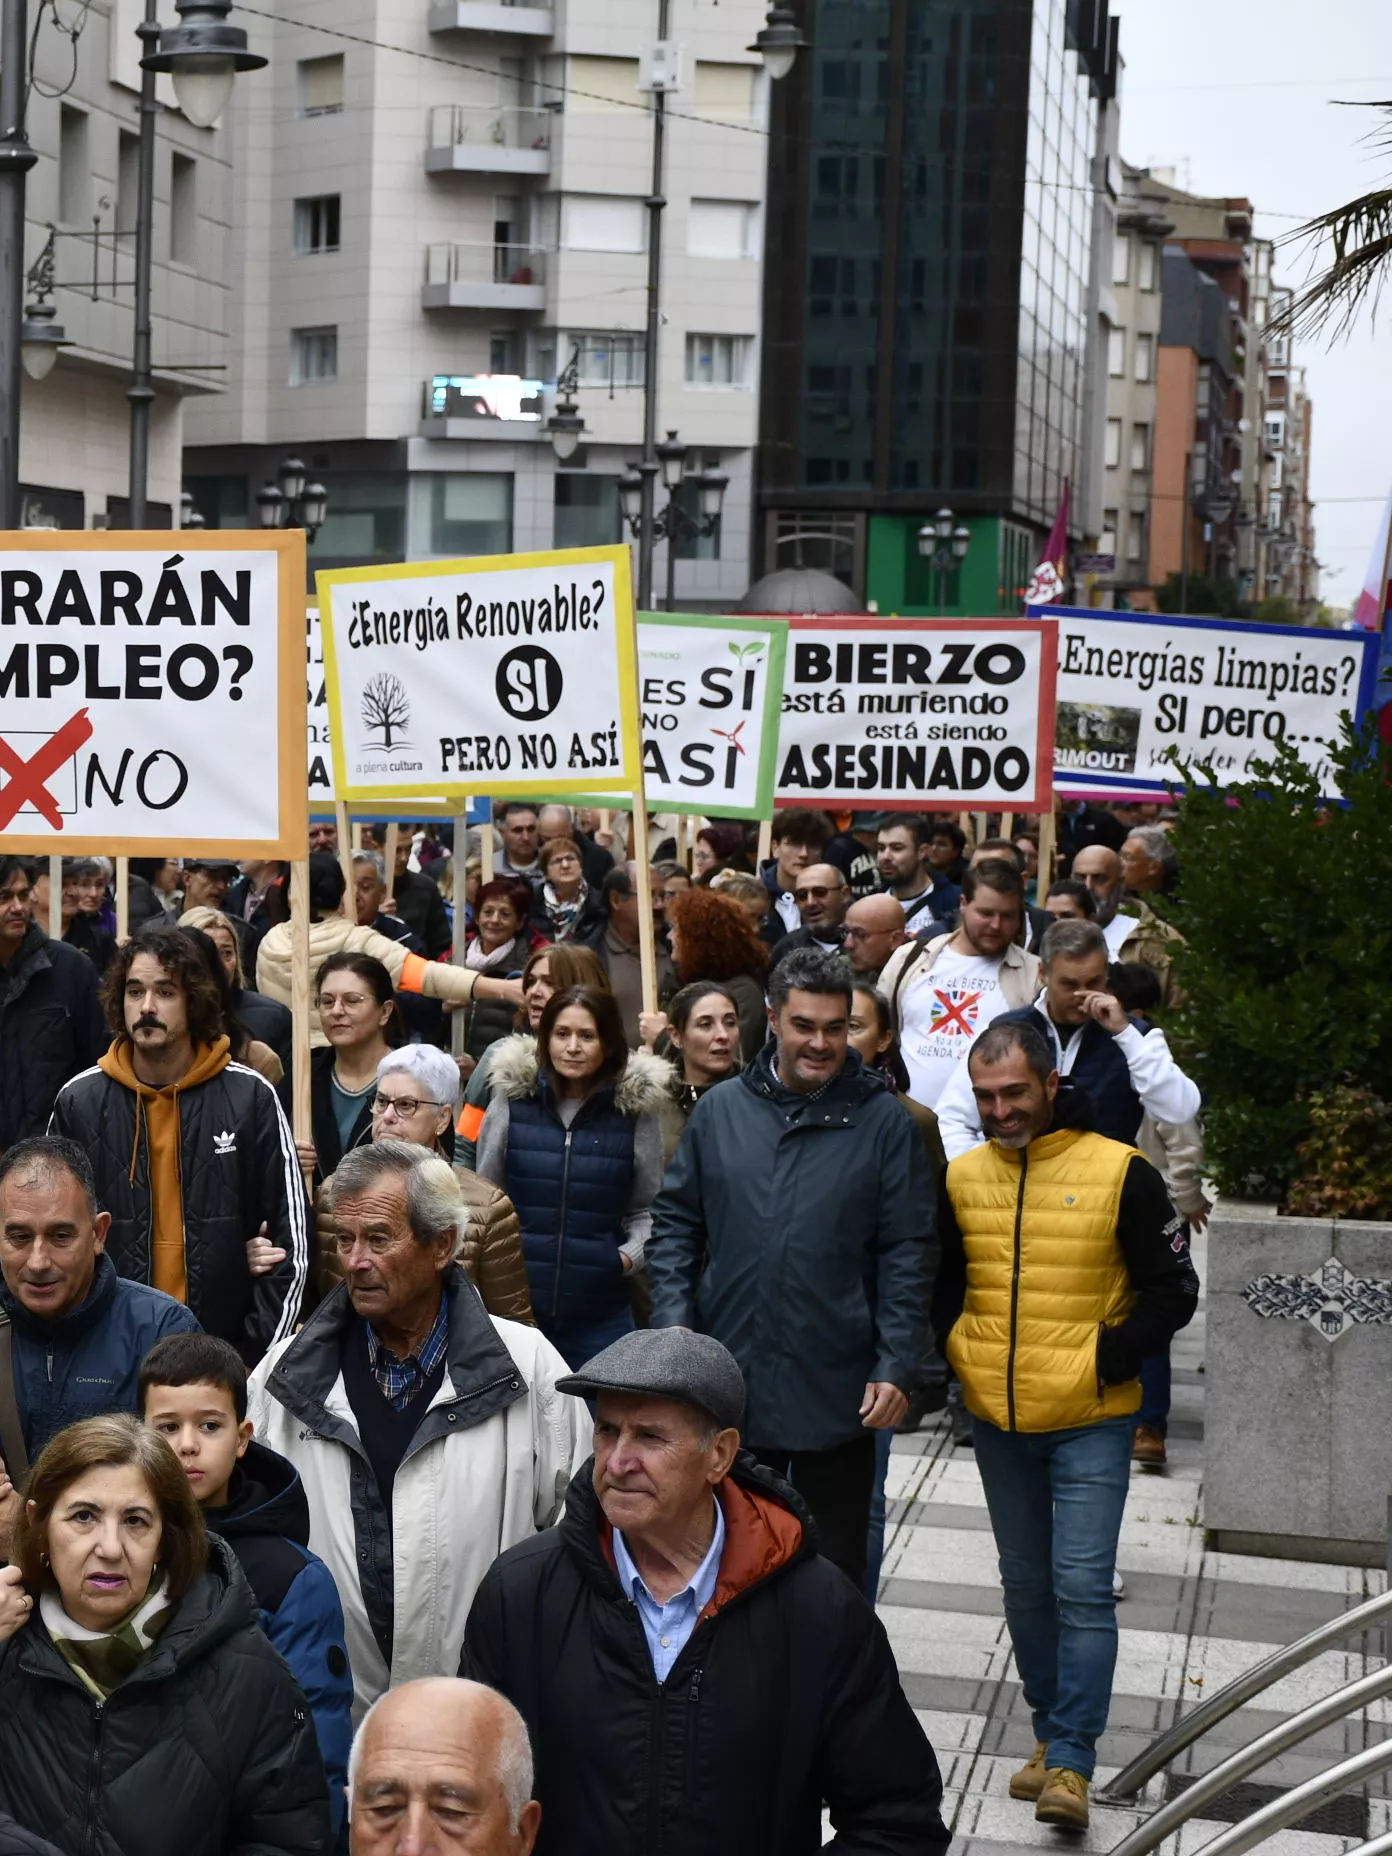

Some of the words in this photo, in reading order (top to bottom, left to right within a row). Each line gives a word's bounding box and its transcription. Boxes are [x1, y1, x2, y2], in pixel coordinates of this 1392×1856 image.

[348, 597, 450, 651] ¿Energía
[457, 579, 605, 640] Renovable?
[506, 657, 550, 712] SI
[794, 643, 1026, 685] BIERZO
[1056, 633, 1206, 690] Energías
[1214, 646, 1356, 701] limpias?
[781, 689, 846, 714] está
[858, 691, 1009, 715] muriendo
[1155, 693, 1188, 733] SI
[439, 735, 508, 772] PERO
[518, 733, 557, 769] NO
[568, 720, 620, 768] ASÍ
[865, 721, 919, 739] está
[927, 723, 1008, 741] siendo
[85, 747, 189, 810] NO
[389, 760, 423, 772] cultura
[778, 744, 1030, 792] ASESINADO
[961, 977, 997, 992] BIERZO
[916, 1045, 953, 1058] AGENDA
